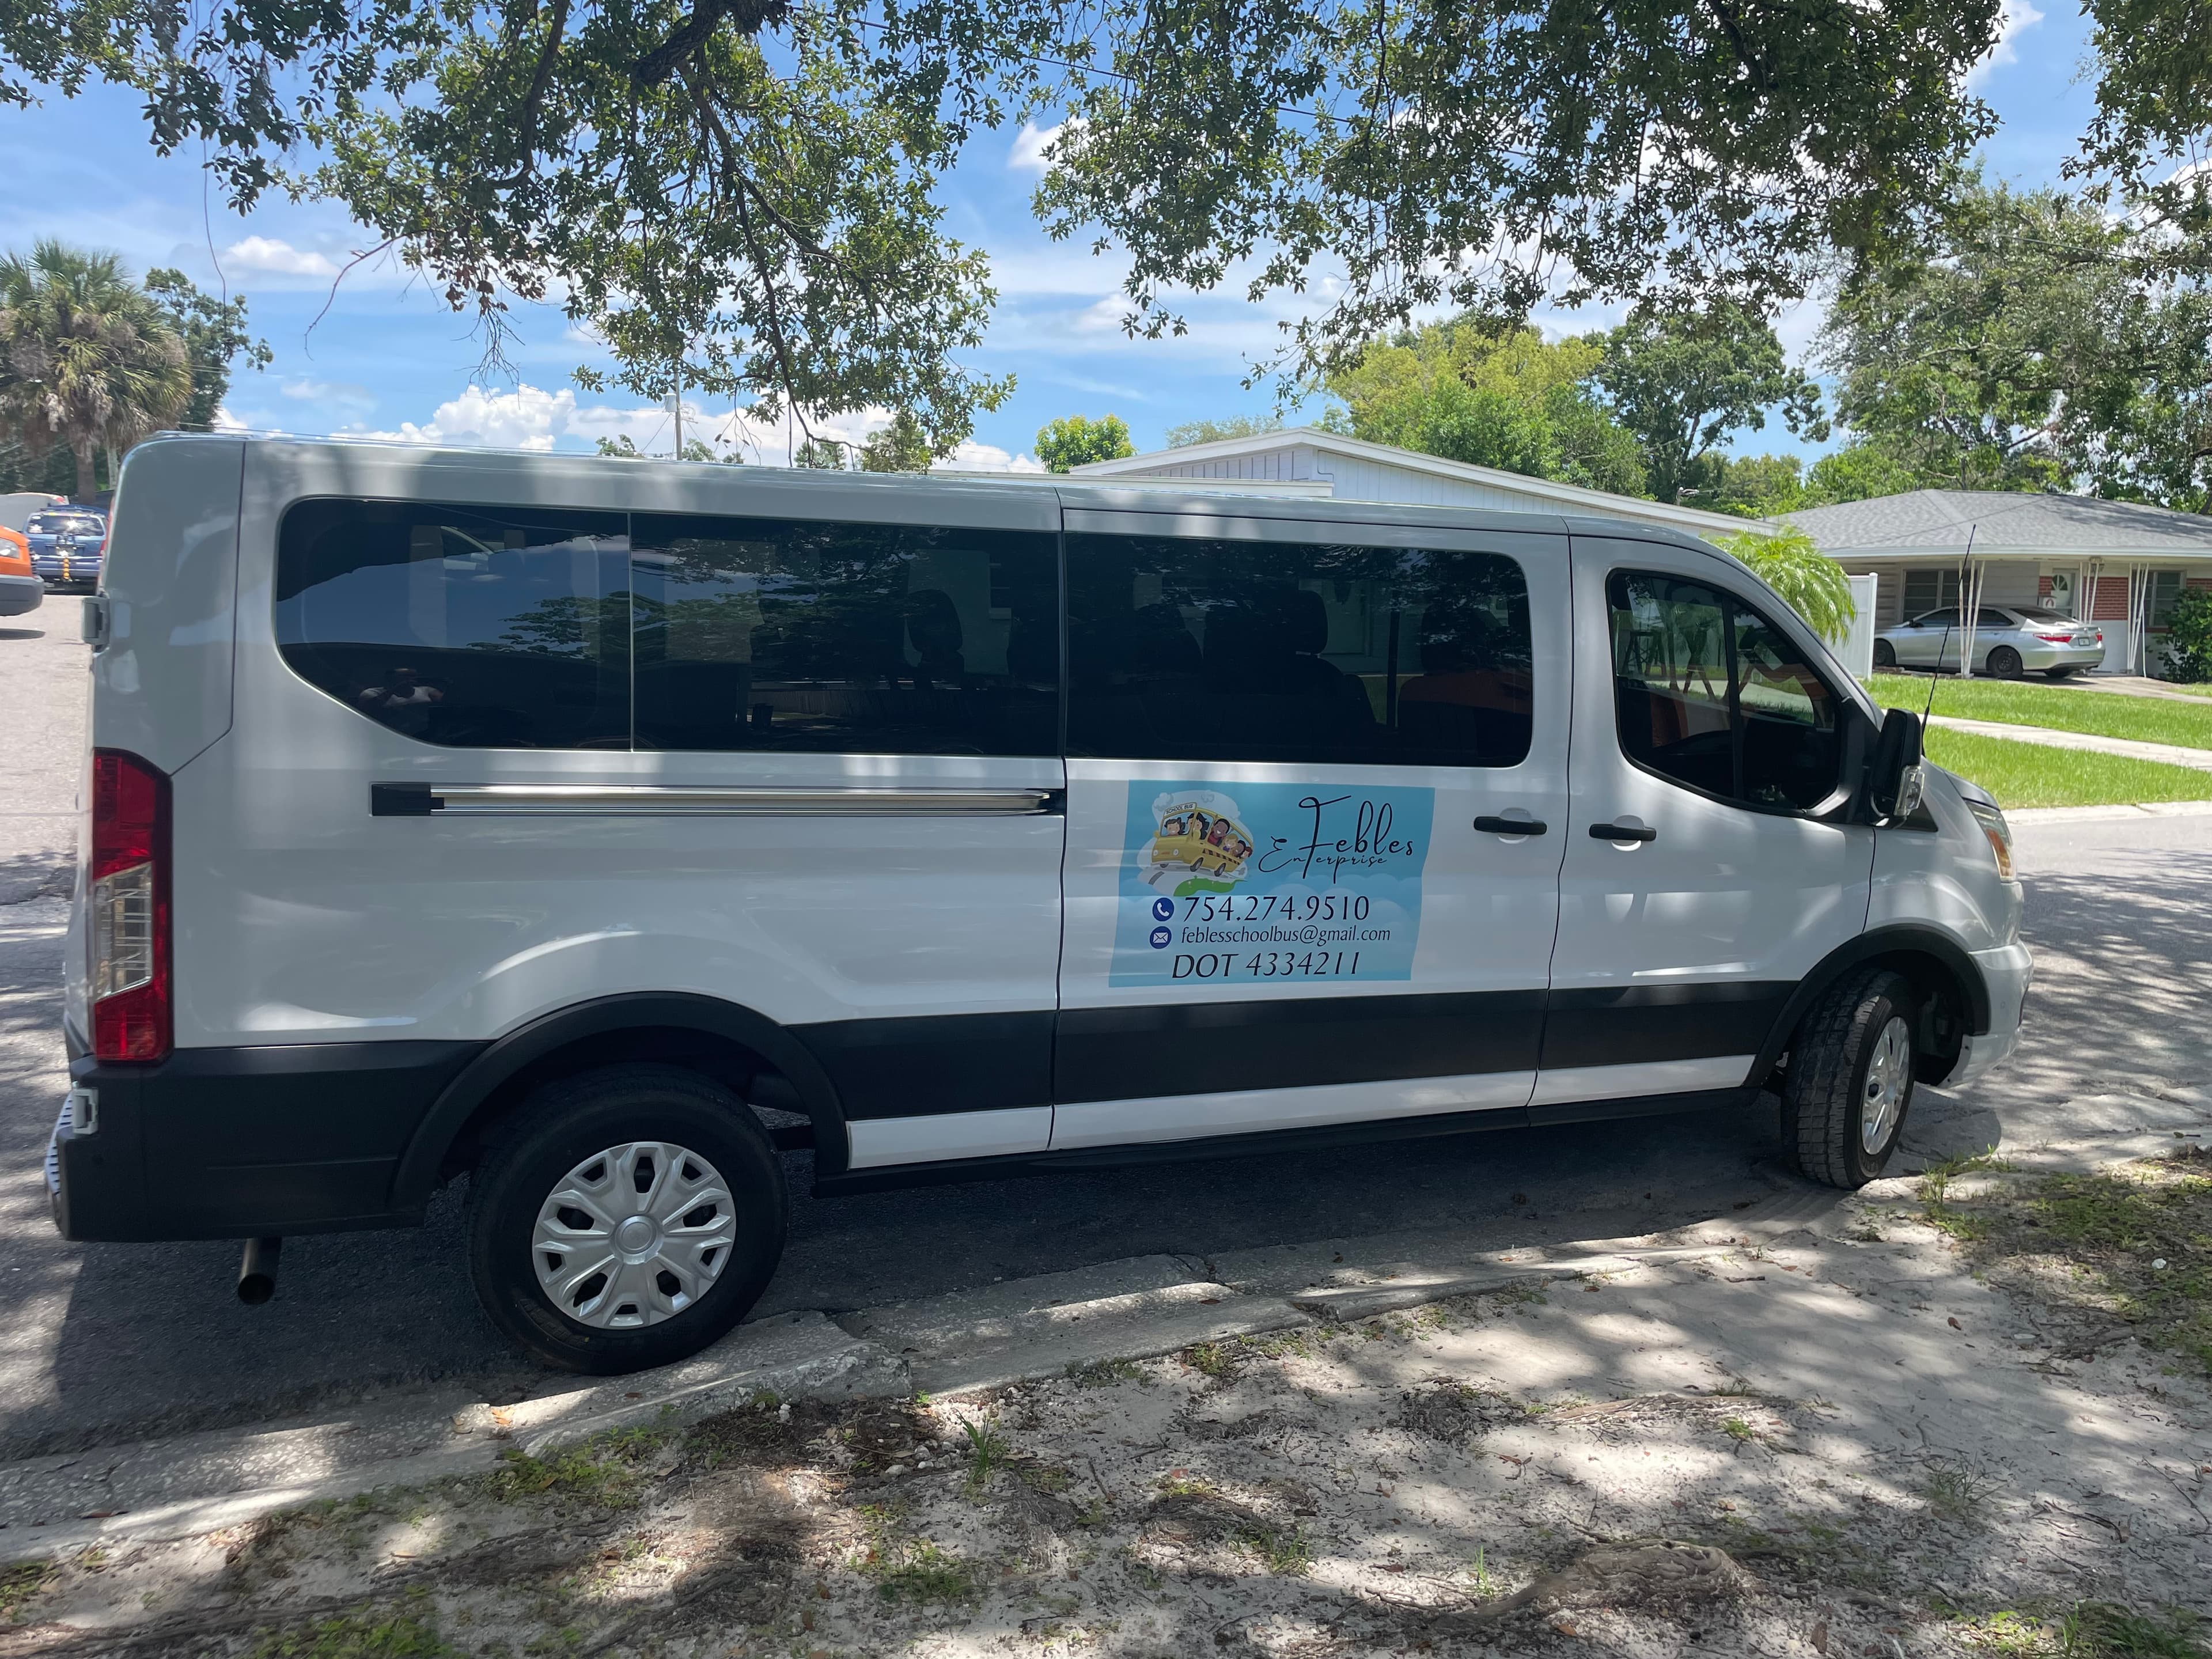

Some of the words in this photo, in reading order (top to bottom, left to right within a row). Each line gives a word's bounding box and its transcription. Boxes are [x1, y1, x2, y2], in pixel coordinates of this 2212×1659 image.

[1166, 805, 1183, 814] SCHOOL
[1298, 795, 1414, 879] Febles
[1183, 895, 1370, 922] 754.274.9510
[1181, 925, 1391, 947] feblesschoolbus@gmail.com
[1172, 953, 1240, 979] DOT
[1245, 952, 1360, 976] 4334211
